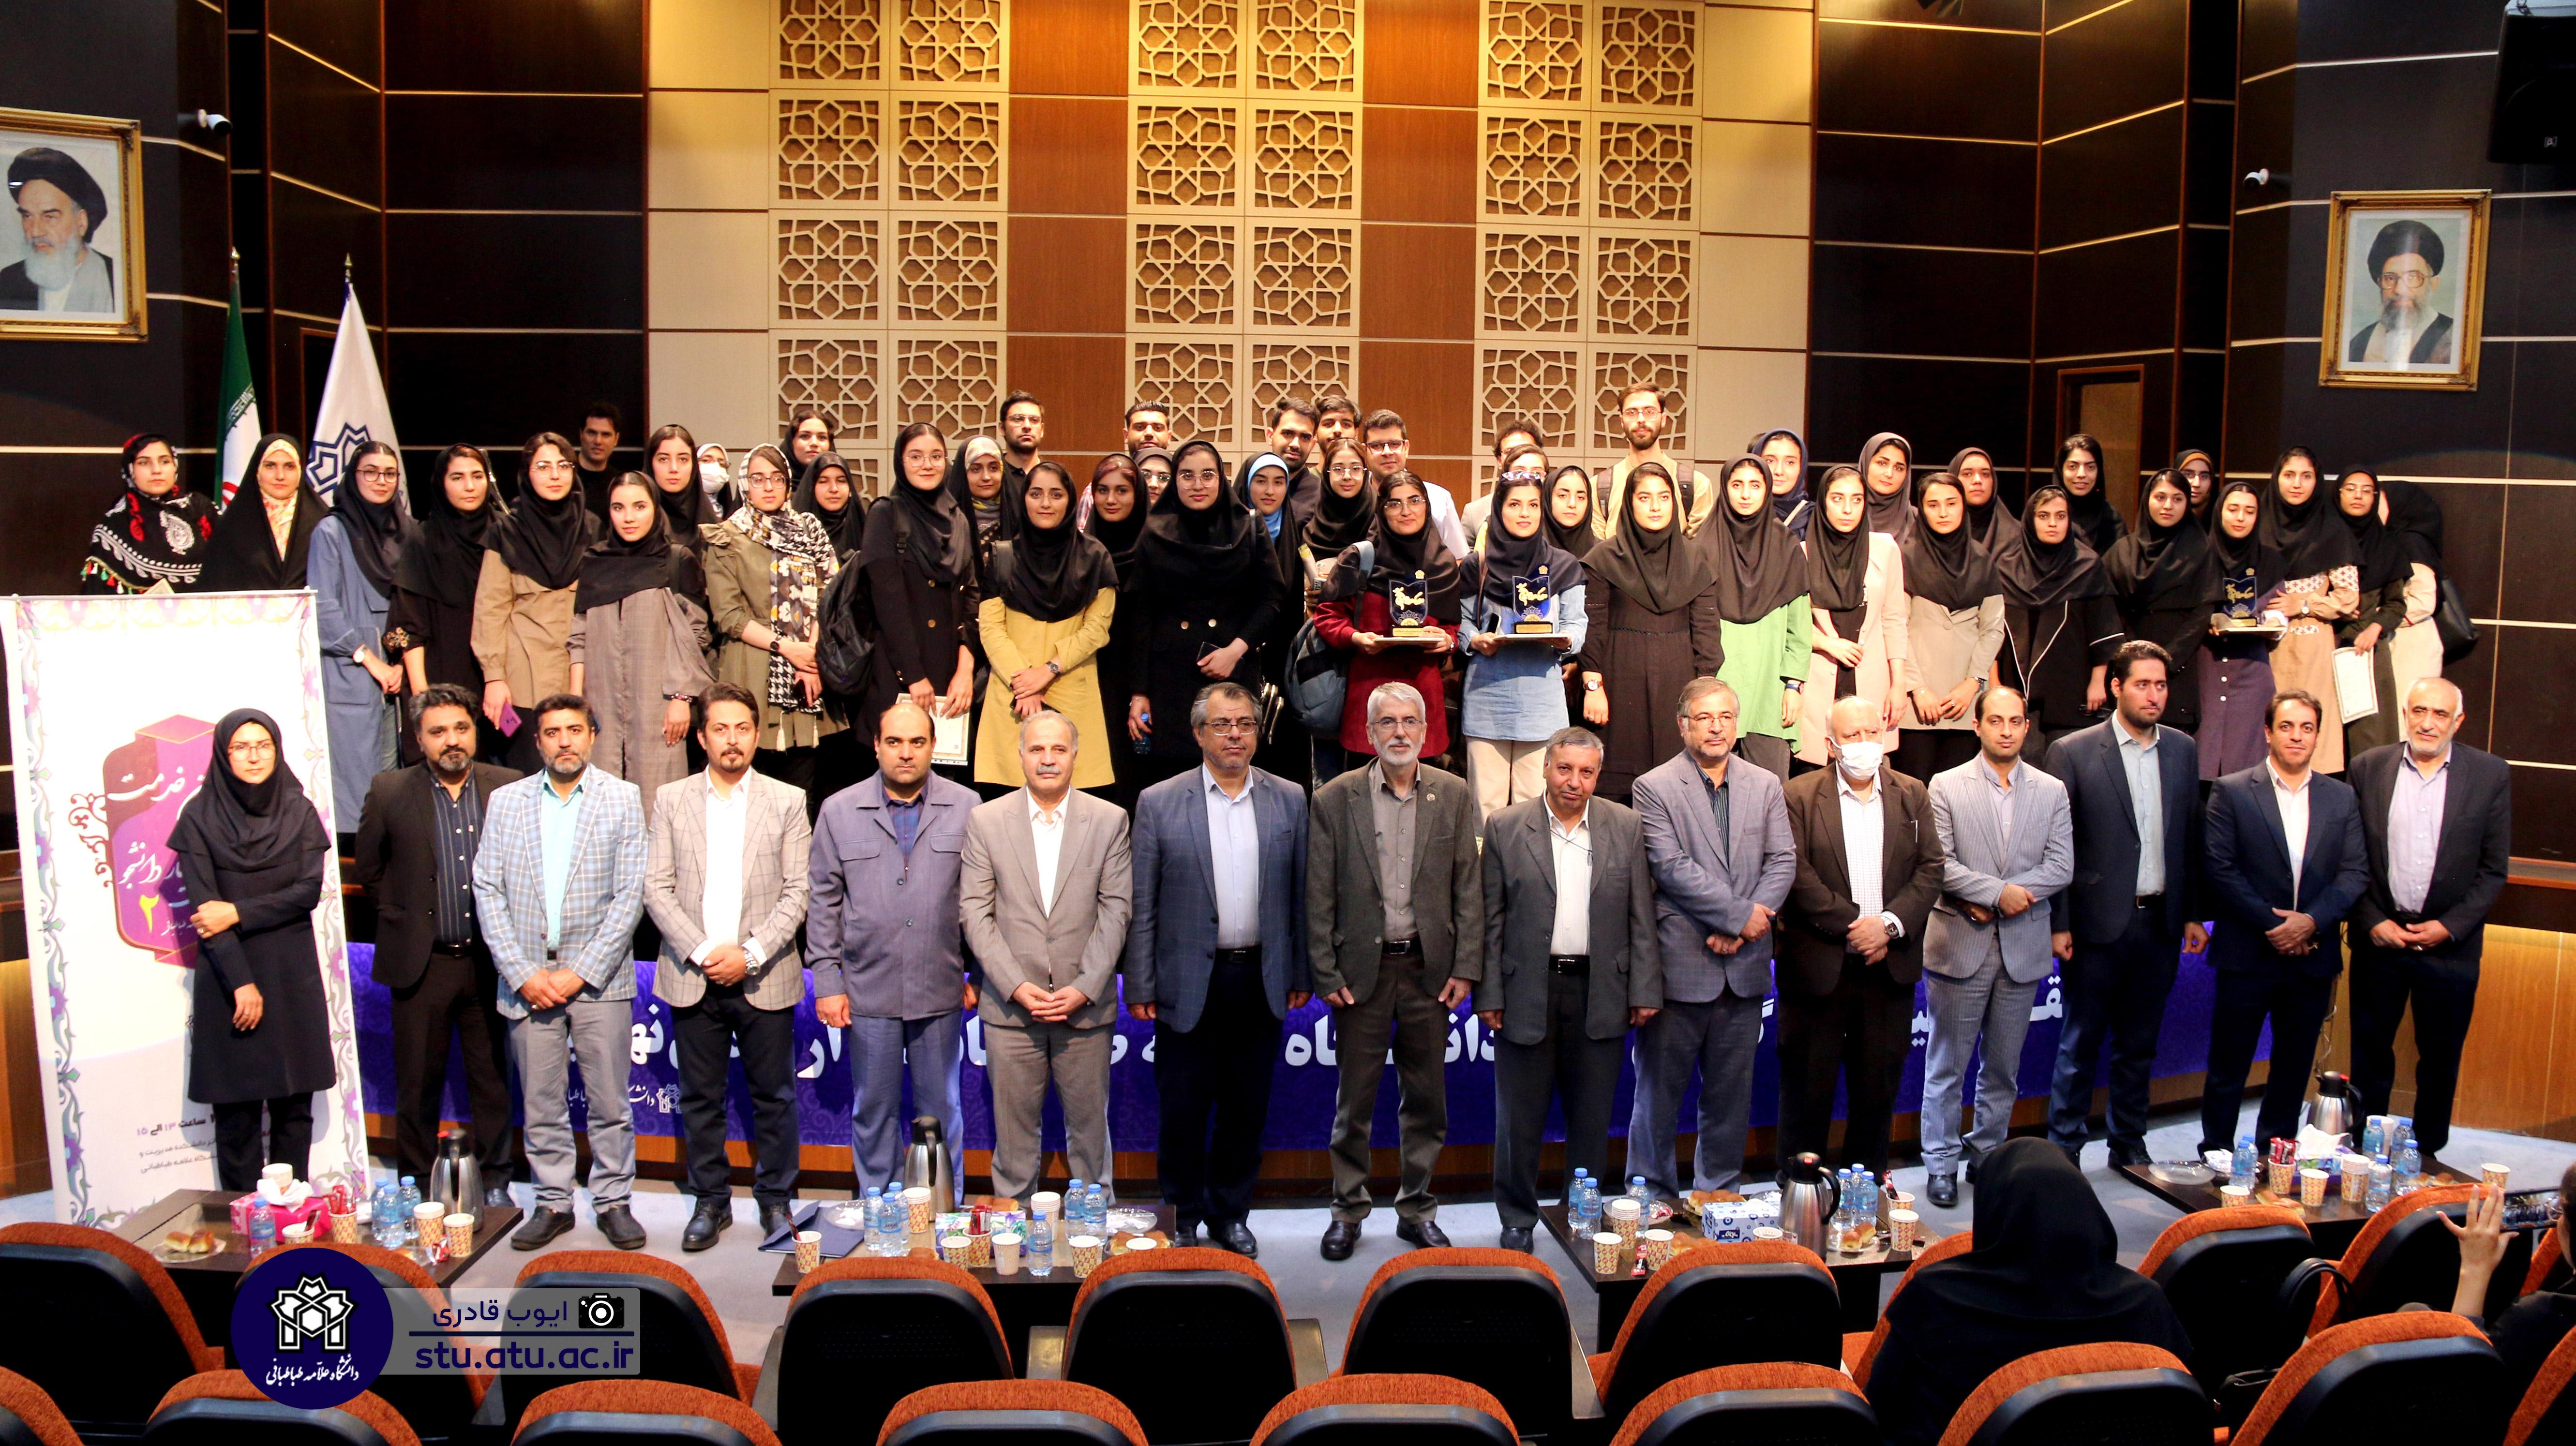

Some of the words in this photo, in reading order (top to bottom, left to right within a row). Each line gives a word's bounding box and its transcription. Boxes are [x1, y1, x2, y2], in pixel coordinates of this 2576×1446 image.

[107, 766, 185, 801] خدمت
[118, 841, 162, 889] دانشجو
[139, 894, 159, 933] ۲
